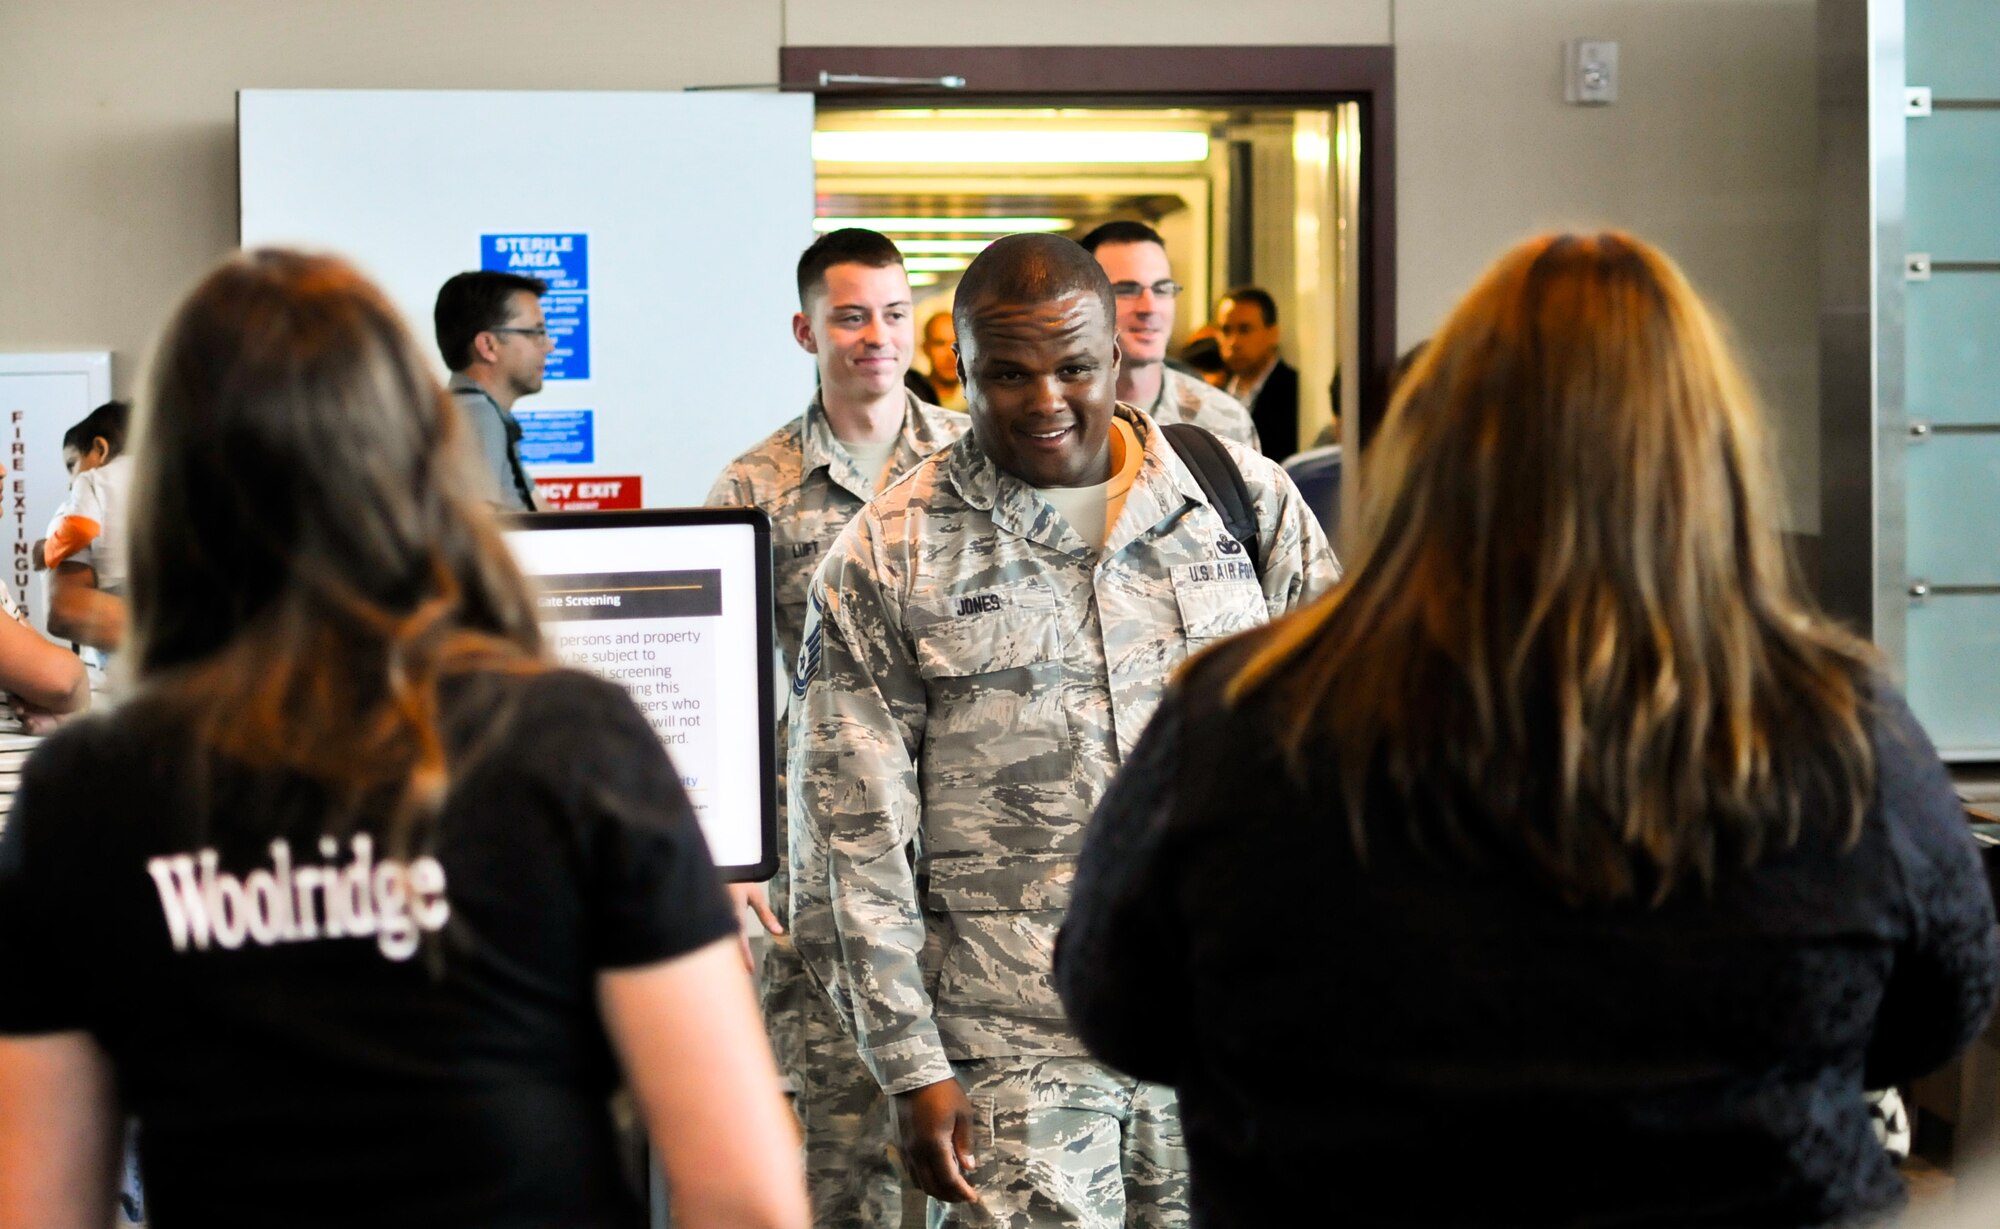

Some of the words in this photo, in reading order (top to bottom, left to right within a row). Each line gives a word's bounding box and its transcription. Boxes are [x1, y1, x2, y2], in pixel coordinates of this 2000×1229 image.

[495, 236, 573, 253] STERILE
[508, 251, 561, 268] AREA
[11, 411, 24, 471] FIRE
[577, 481, 622, 499] EXIT
[13, 479, 29, 618] EXTINGUIS
[1188, 564, 1214, 582] U.S.
[1216, 562, 1237, 580] AIR
[565, 594, 621, 607] Screening
[957, 594, 1000, 616] JONES
[560, 634, 612, 649] persons
[615, 632, 640, 645] and
[643, 631, 701, 645] property
[572, 650, 588, 663] be
[592, 650, 638, 664] subject
[642, 650, 656, 661] to
[609, 665, 672, 679] screening
[655, 682, 680, 694] this
[672, 698, 701, 710] who
[651, 715, 675, 728] will
[679, 715, 701, 727] not
[148, 831, 449, 961] Woolridge
